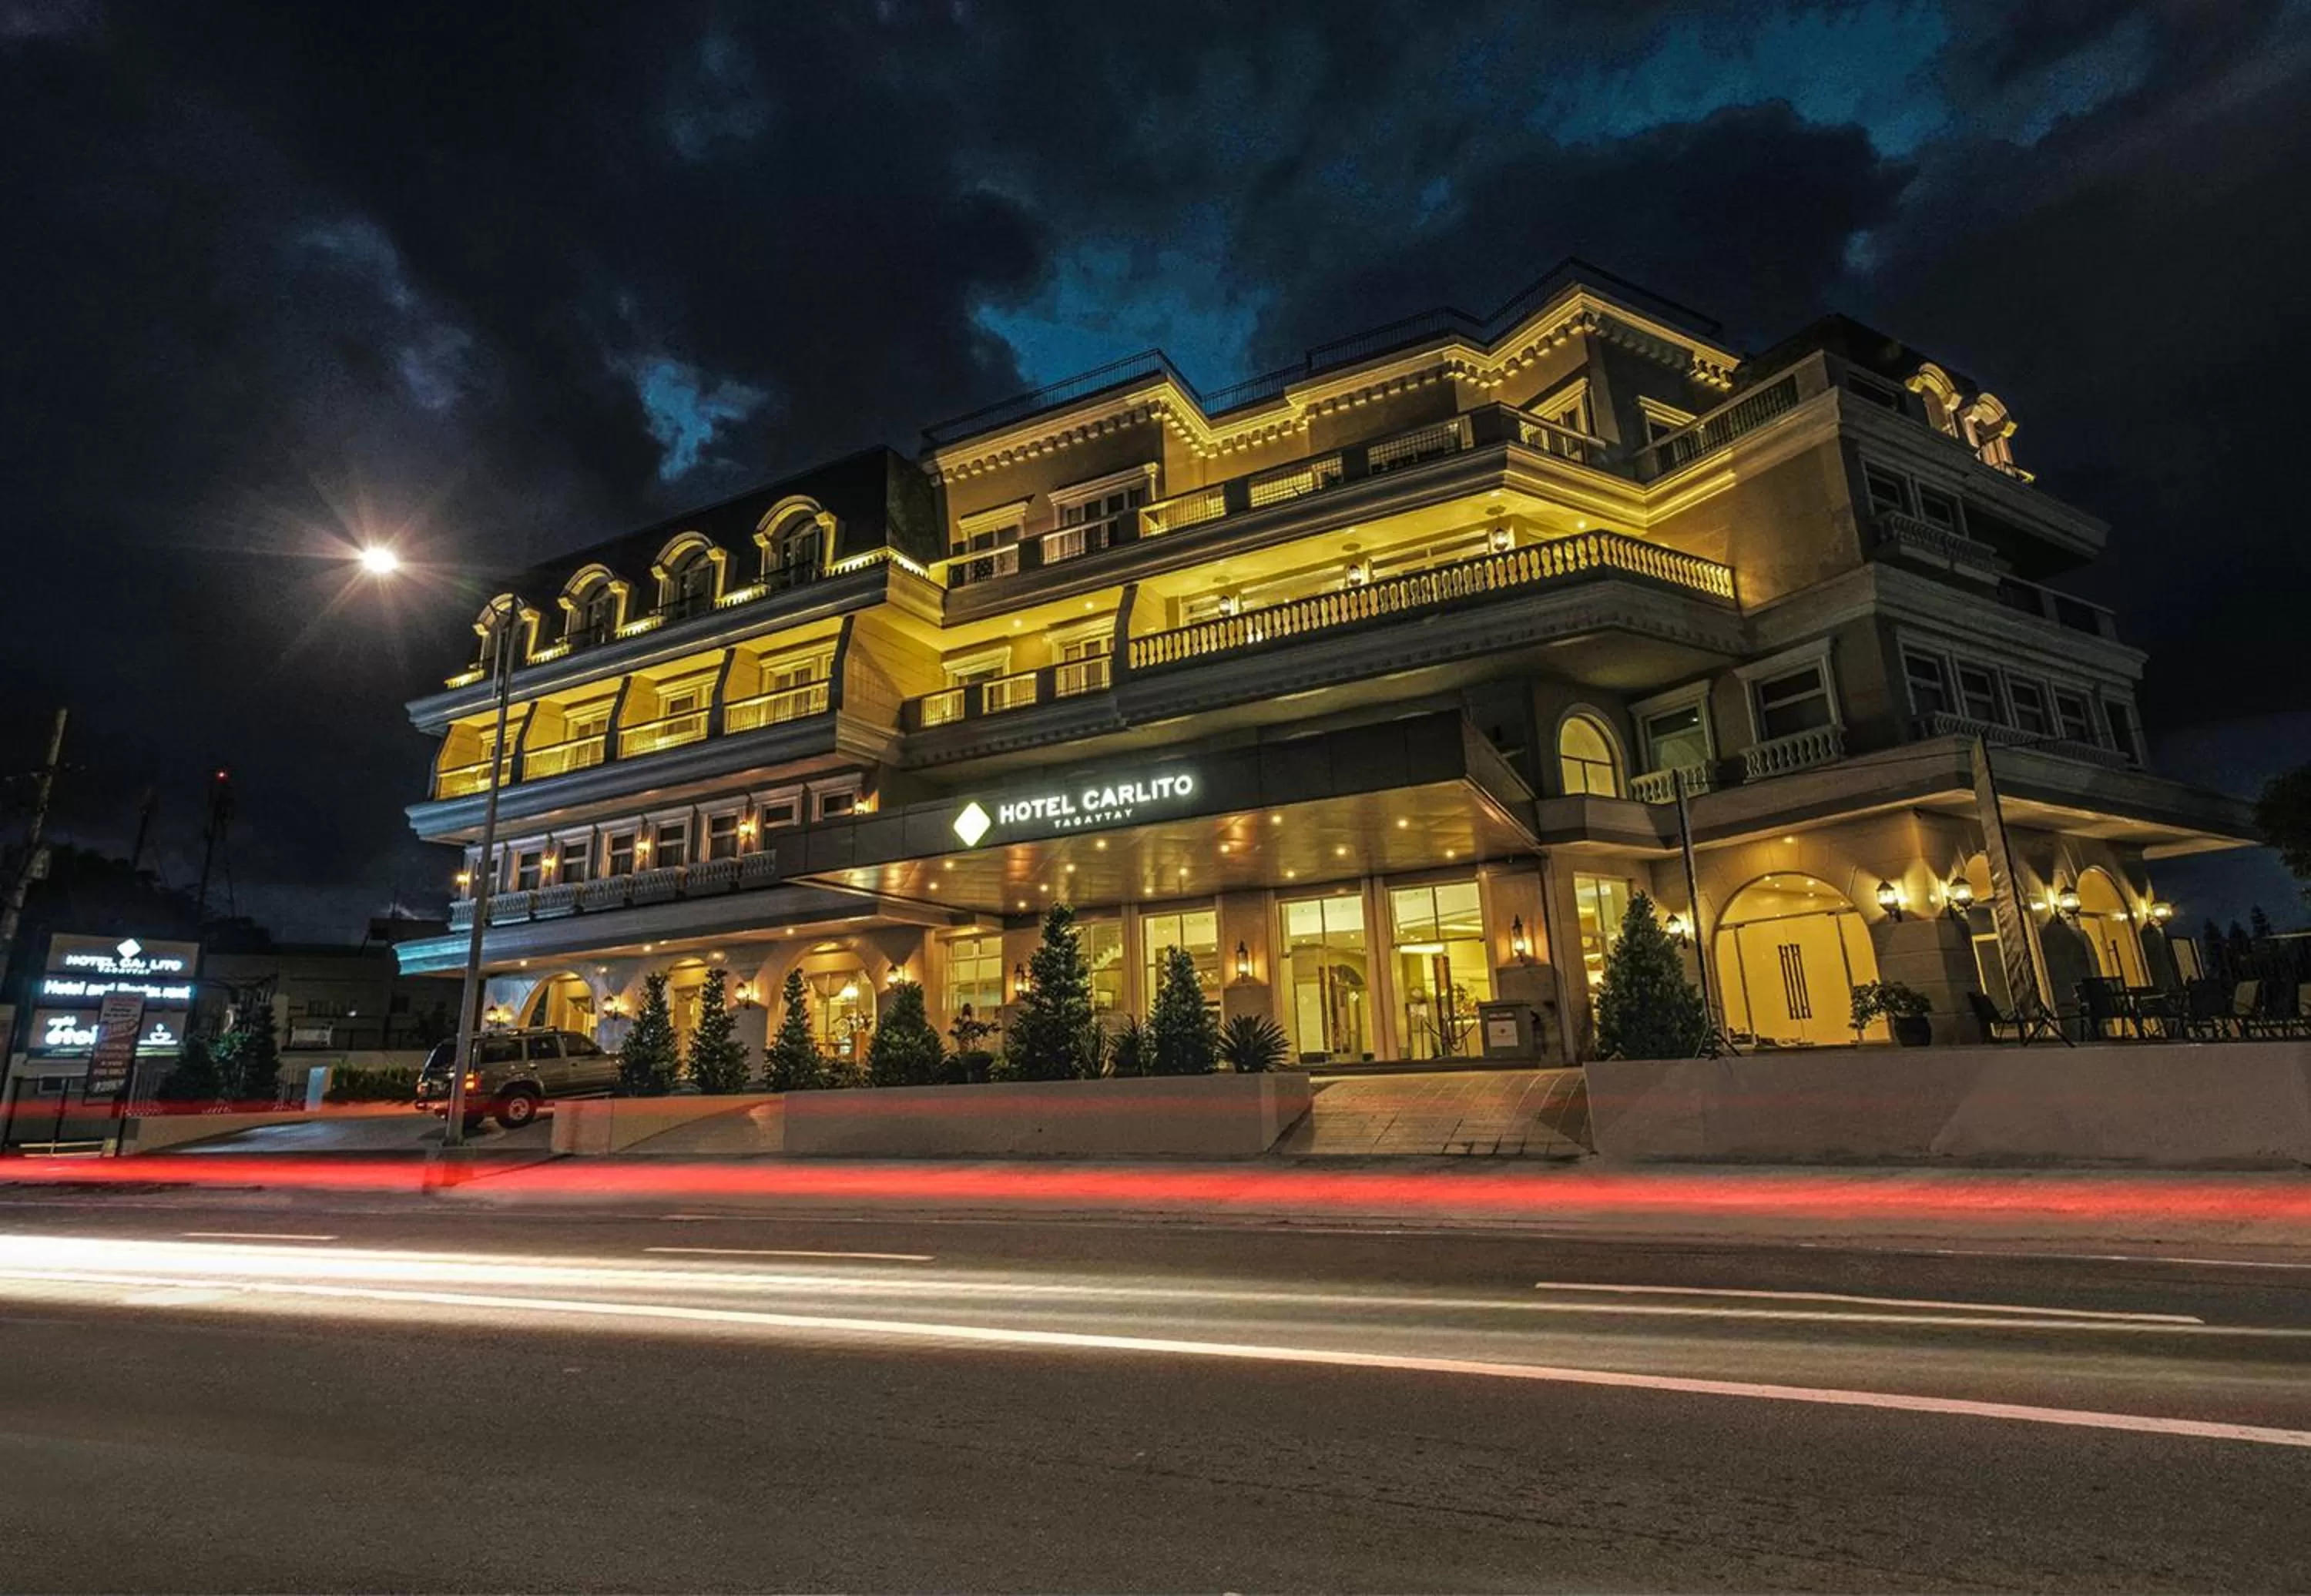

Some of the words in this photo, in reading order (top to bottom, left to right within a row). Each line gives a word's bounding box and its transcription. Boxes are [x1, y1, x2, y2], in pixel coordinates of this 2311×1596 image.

[999, 794, 1076, 824] HOTEL
[1082, 774, 1193, 810] CARLITO
[1053, 809, 1132, 829] TAGAYTAY
[65, 954, 116, 967] HOTEL
[119, 957, 183, 971] CALITO
[43, 979, 86, 995] Hotel
